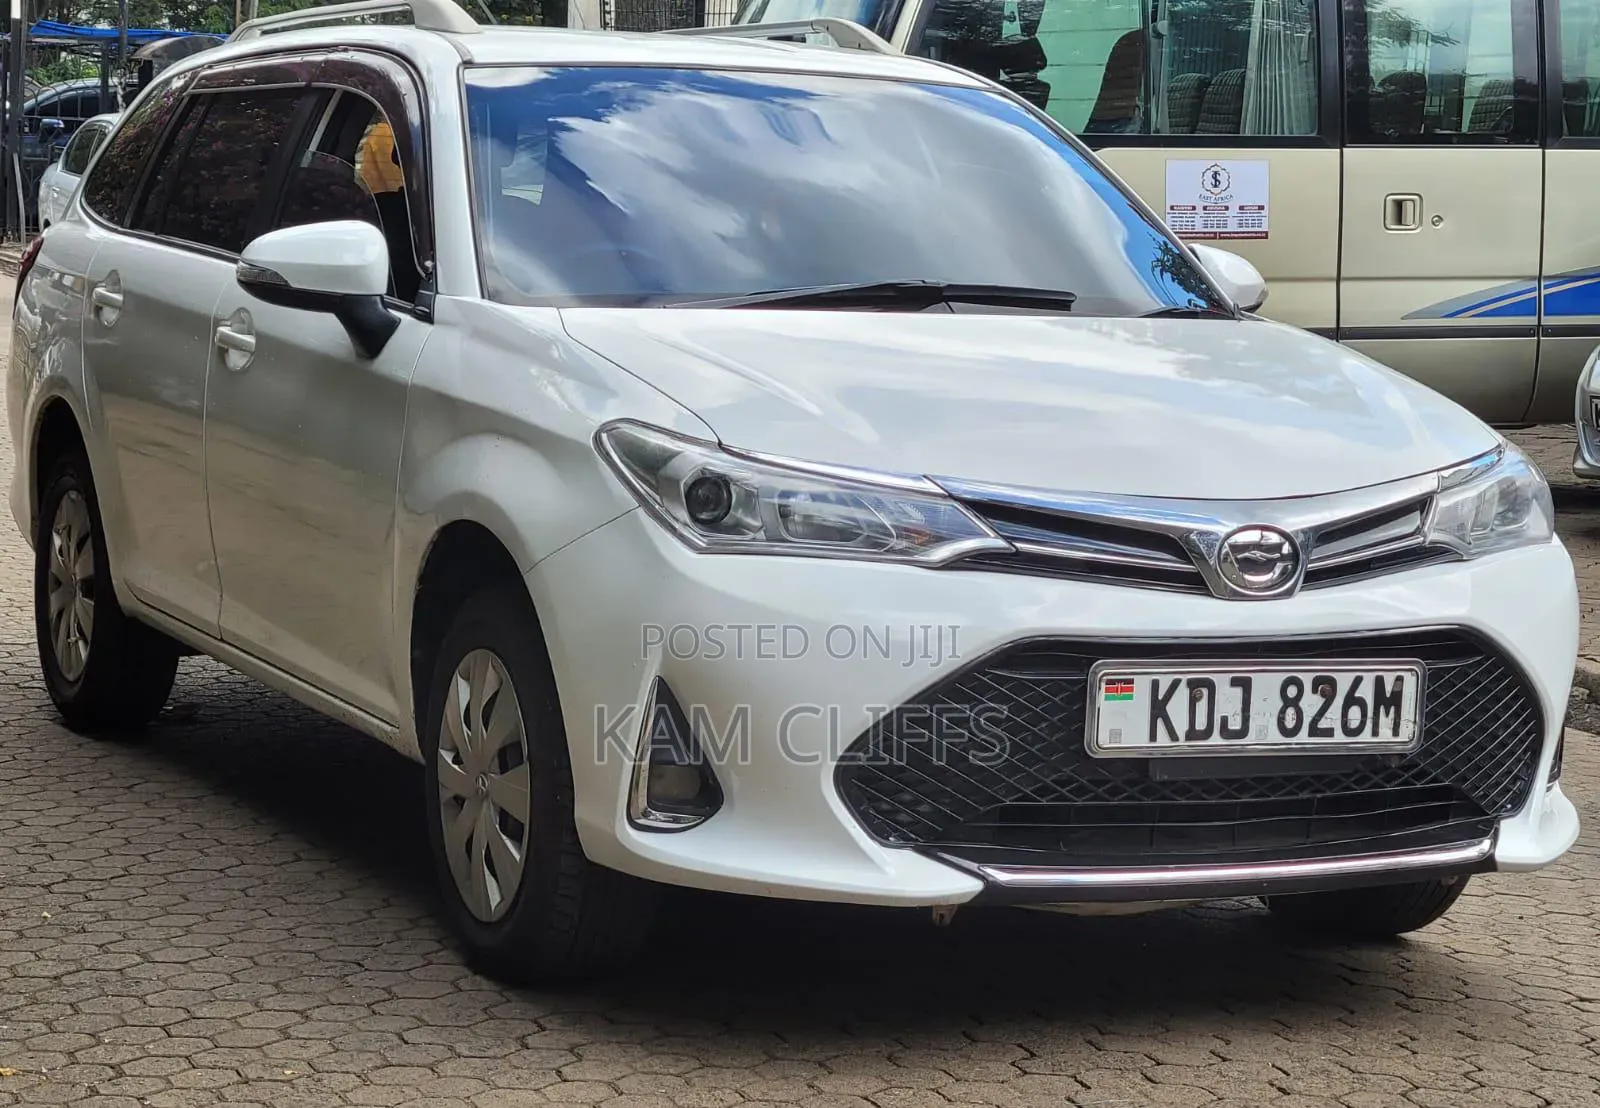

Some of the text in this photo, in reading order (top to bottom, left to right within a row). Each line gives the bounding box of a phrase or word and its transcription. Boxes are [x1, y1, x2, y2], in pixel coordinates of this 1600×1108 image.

[1214, 194, 1234, 202] AFRICA
[1149, 675, 1404, 743] KDJ 826M
